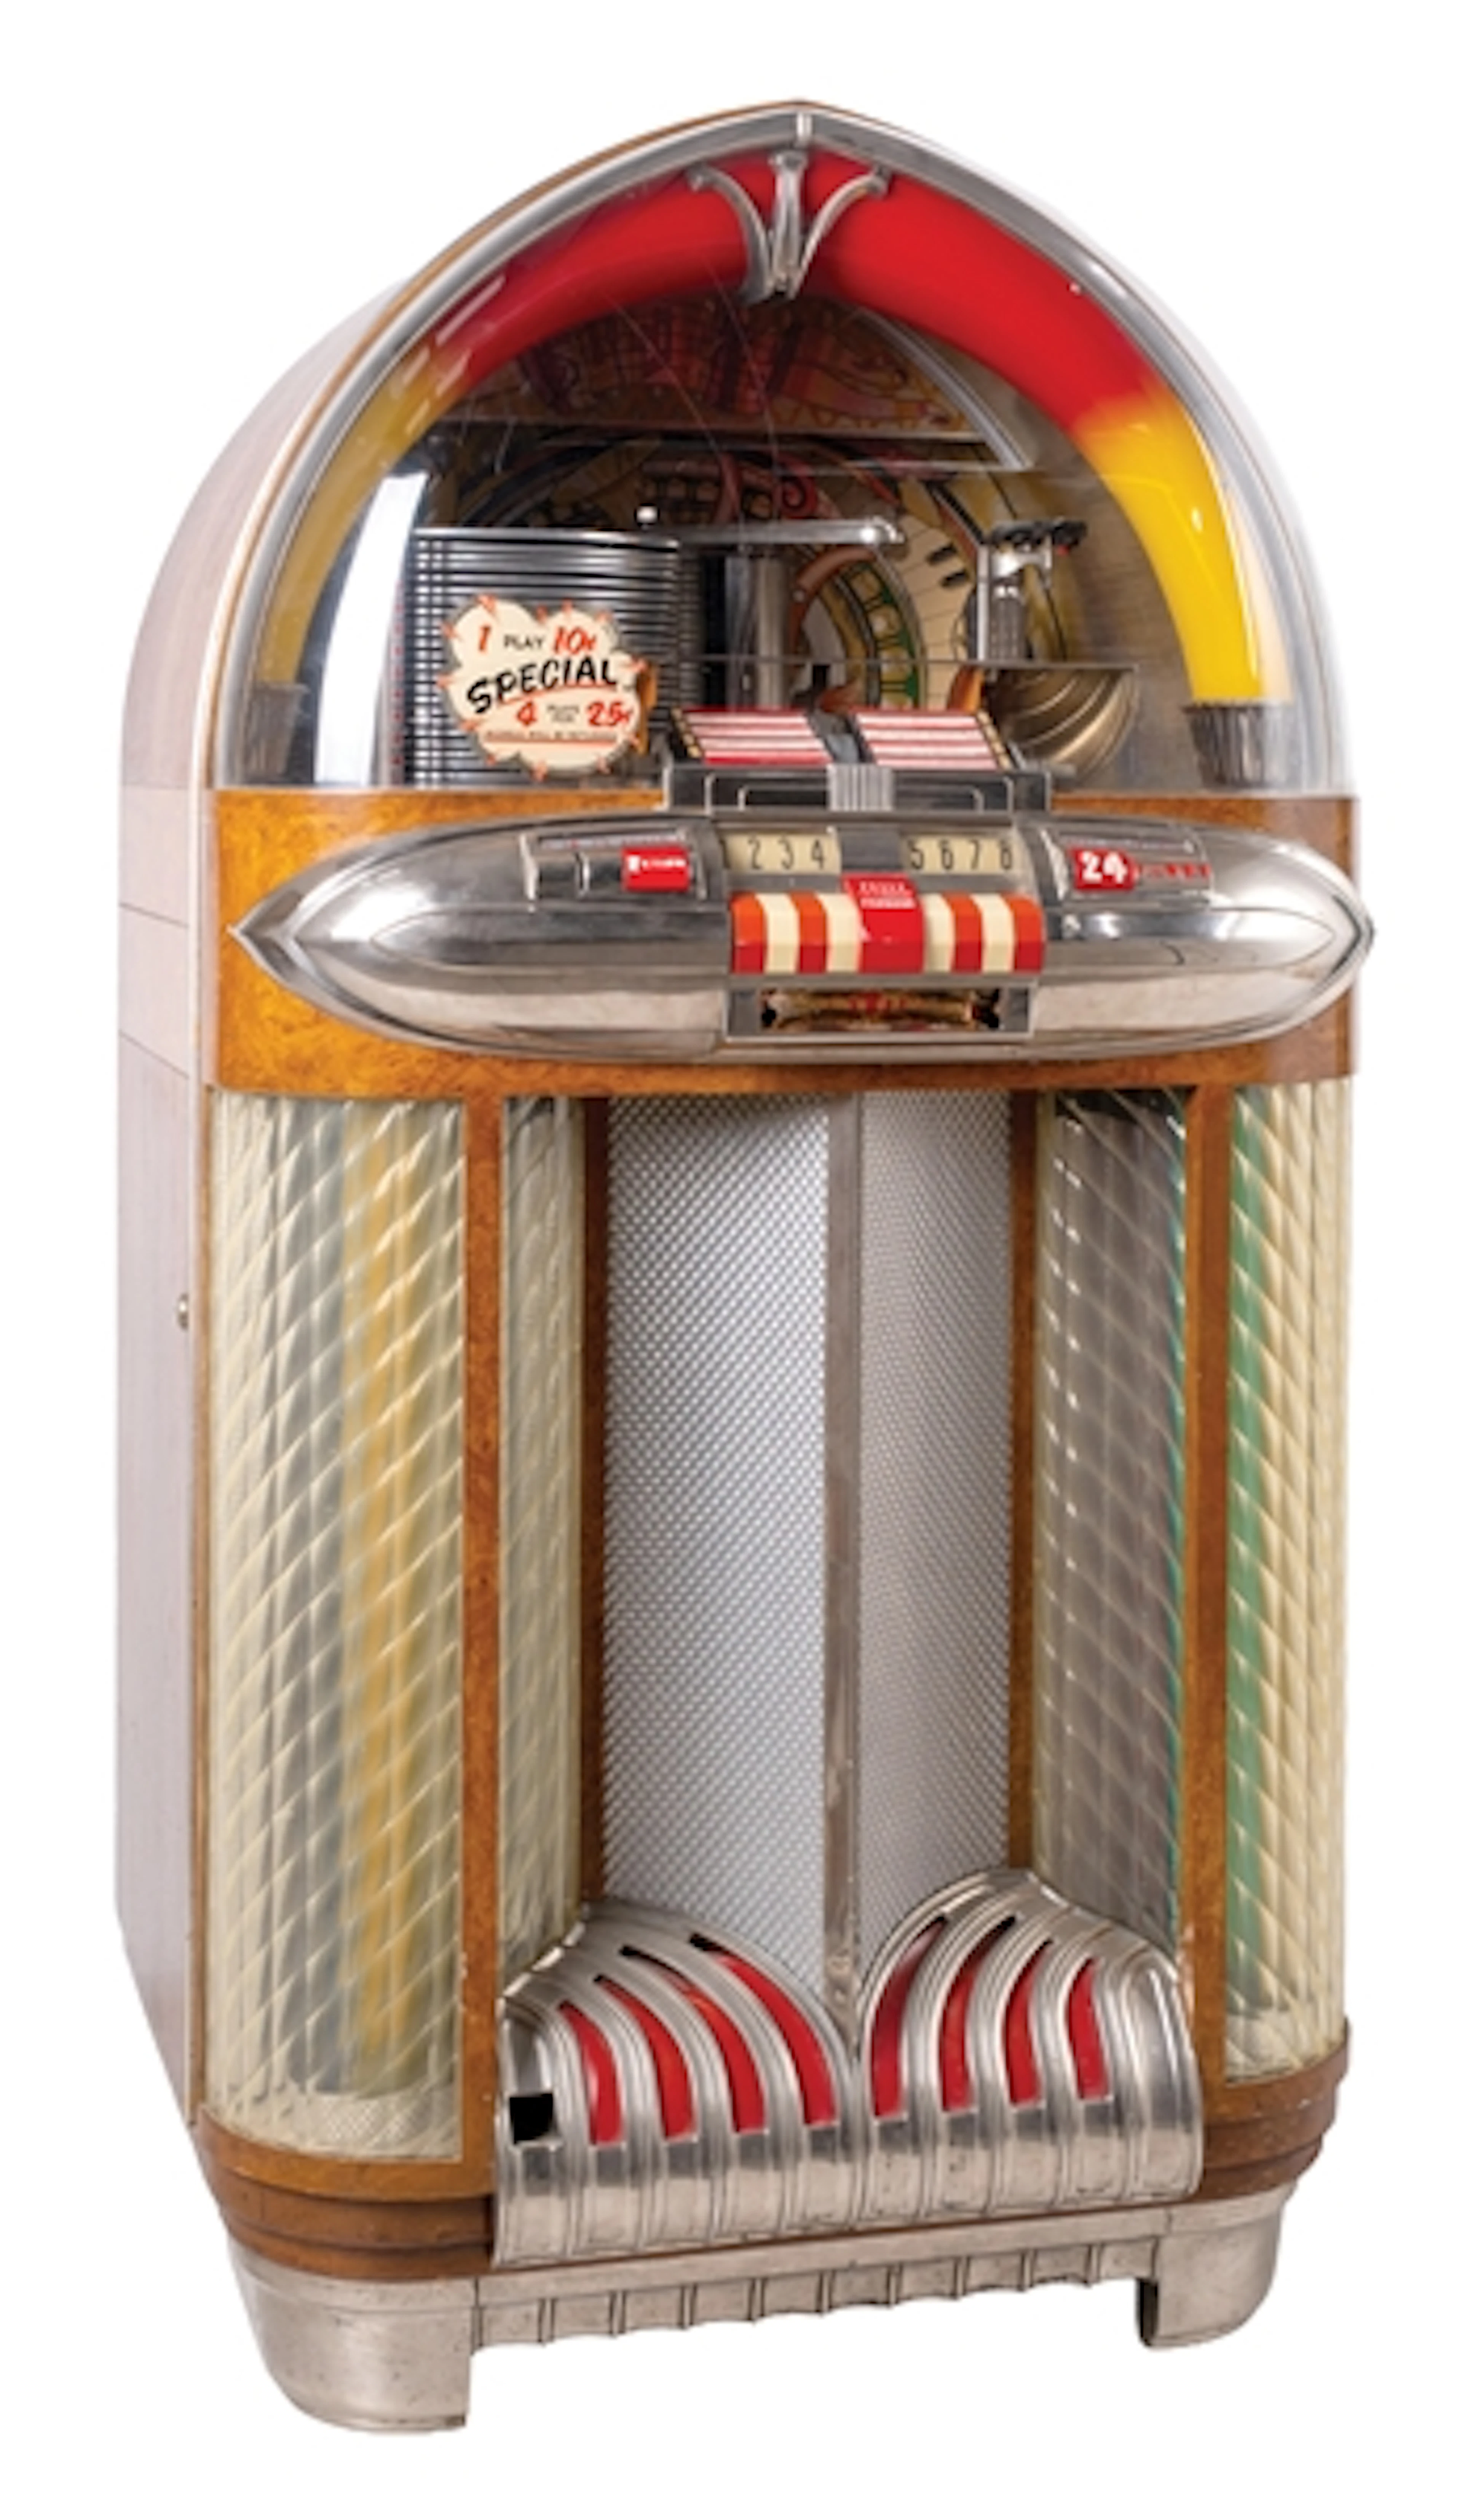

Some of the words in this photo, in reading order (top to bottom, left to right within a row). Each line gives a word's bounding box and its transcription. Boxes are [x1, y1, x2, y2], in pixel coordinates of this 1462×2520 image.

[479, 624, 491, 651] 1
[504, 634, 544, 648] PLAY
[467, 656, 617, 714] SPECIAL
[517, 700, 537, 727] 4
[747, 837, 763, 870] 2
[778, 837, 795, 870] 3
[811, 838, 825, 869] 4
[907, 838, 924, 870] 5
[938, 838, 954, 870] 6
[966, 838, 981, 869] 7
[999, 838, 1013, 870] 8
[1079, 850, 1128, 883] 24
